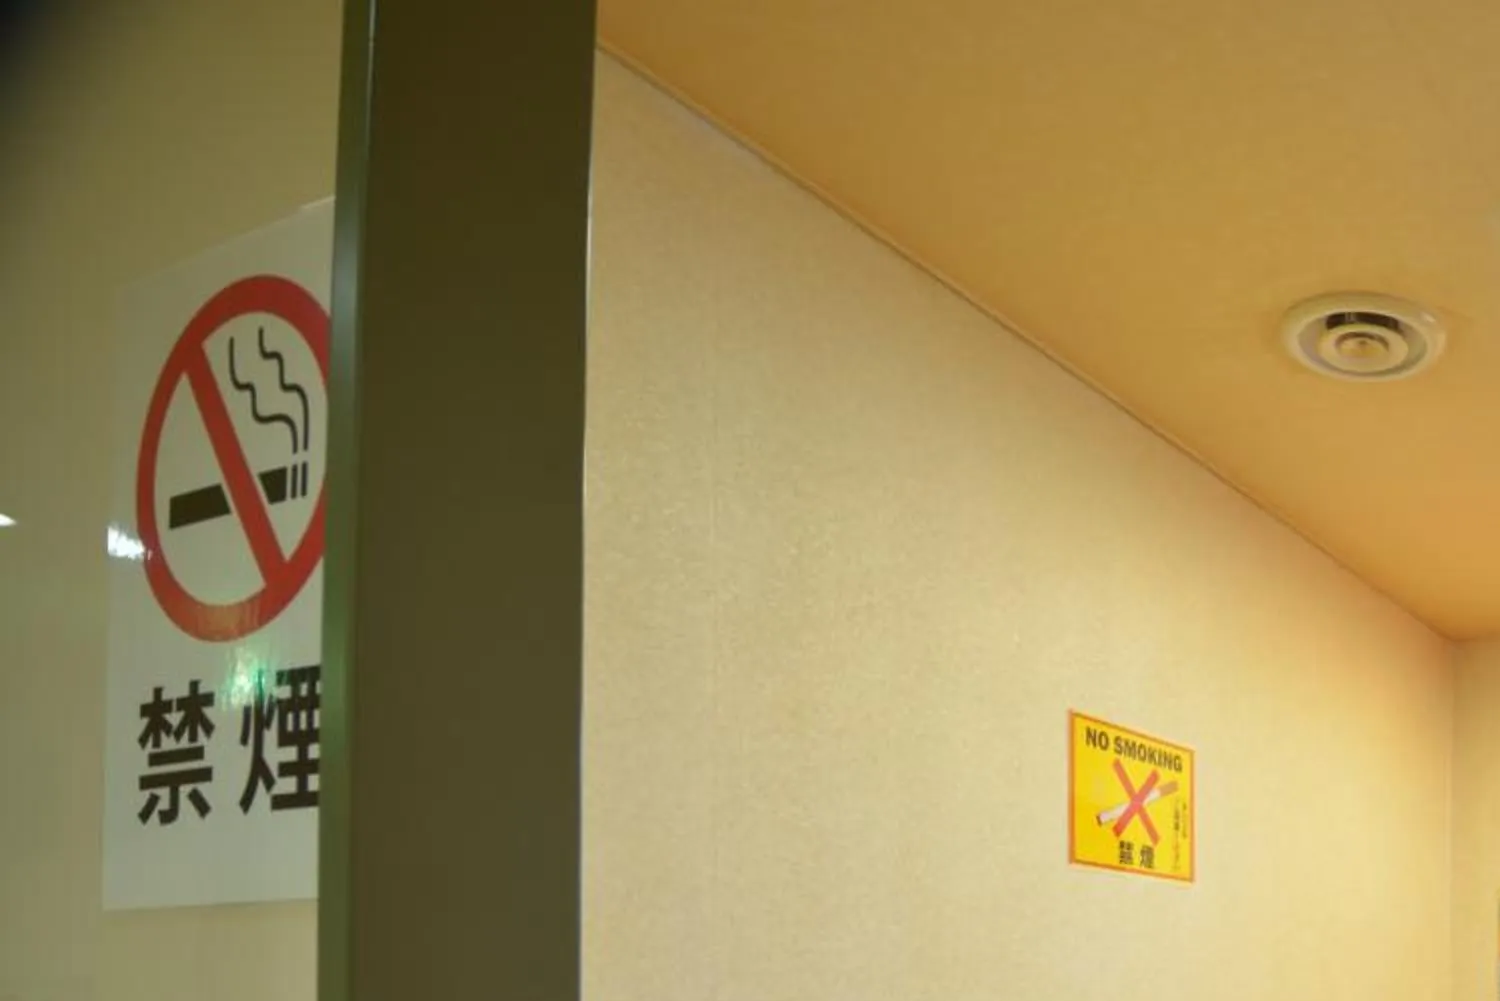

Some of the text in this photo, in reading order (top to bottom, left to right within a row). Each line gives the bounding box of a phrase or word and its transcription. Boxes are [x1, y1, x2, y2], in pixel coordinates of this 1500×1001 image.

[137, 664, 321, 826] 禁煙
[1085, 726, 1183, 772] NO SMOKING
[1119, 840, 1155, 869] 禁煙
